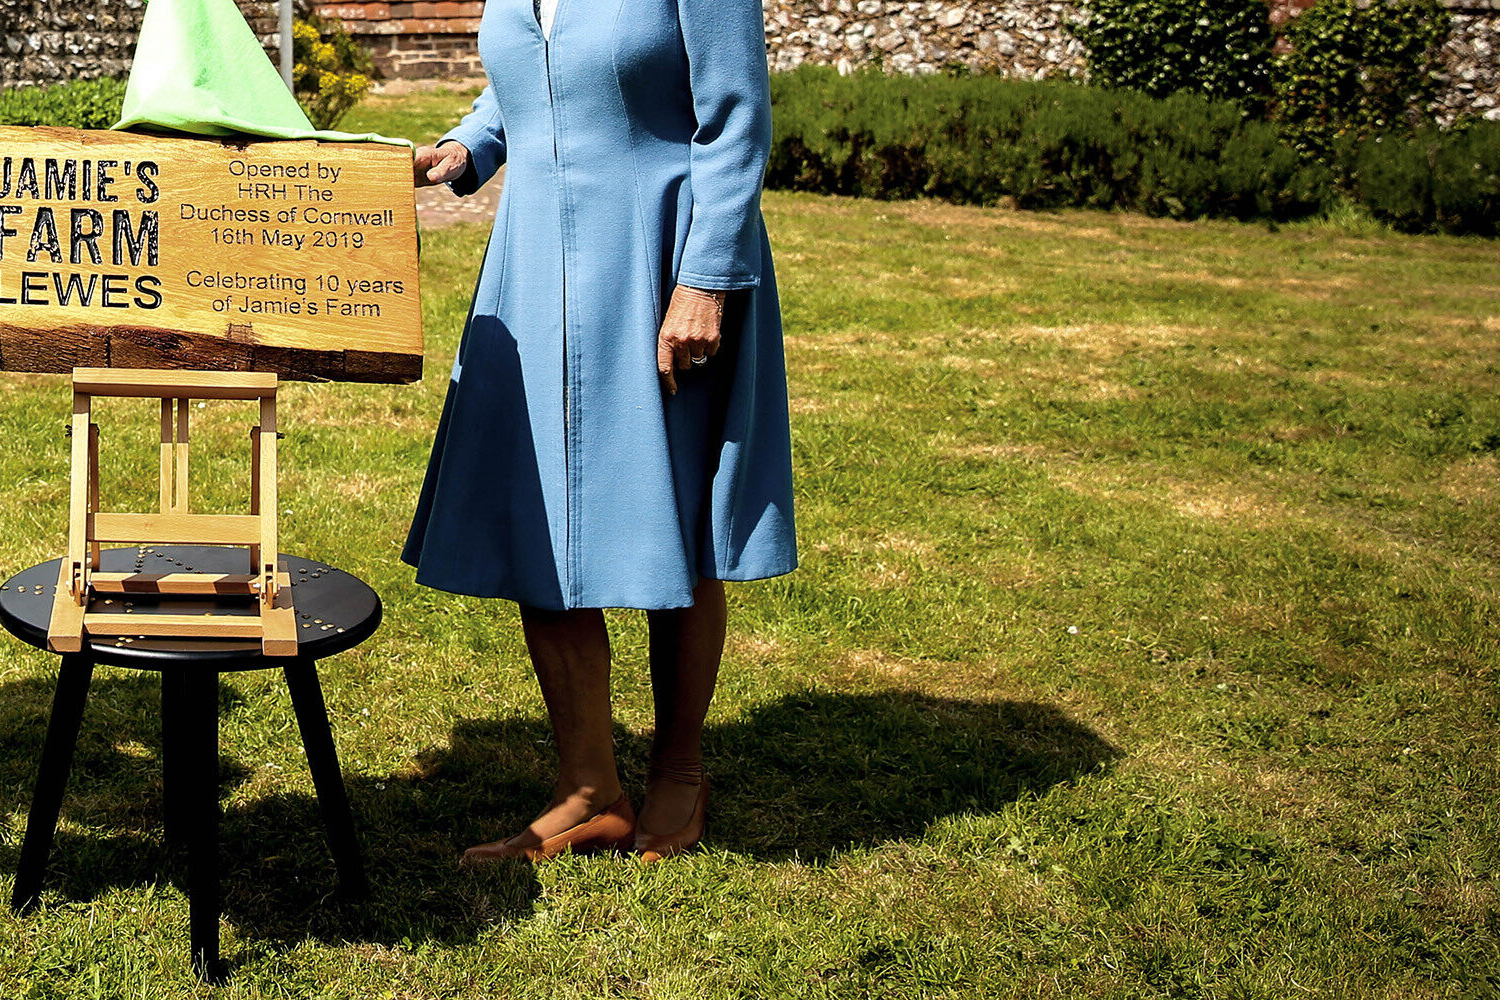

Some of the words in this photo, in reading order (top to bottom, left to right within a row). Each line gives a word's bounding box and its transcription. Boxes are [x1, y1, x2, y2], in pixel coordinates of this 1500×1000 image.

[228, 160, 310, 181] Opened
[317, 162, 342, 184] by
[238, 182, 288, 201] HRH
[294, 184, 334, 202] The
[180, 203, 270, 223] Duchess
[276, 206, 298, 224] of
[303, 207, 394, 227] Cornwall
[211, 227, 254, 246] 16th
[262, 229, 306, 251] May
[312, 231, 365, 249] 2019
[186, 270, 307, 296] Celebrating
[315, 274, 340, 292] 10
[346, 278, 405, 297] years
[212, 295, 233, 312] of
[238, 296, 319, 316] Jamie's
[326, 298, 381, 317] Farm
